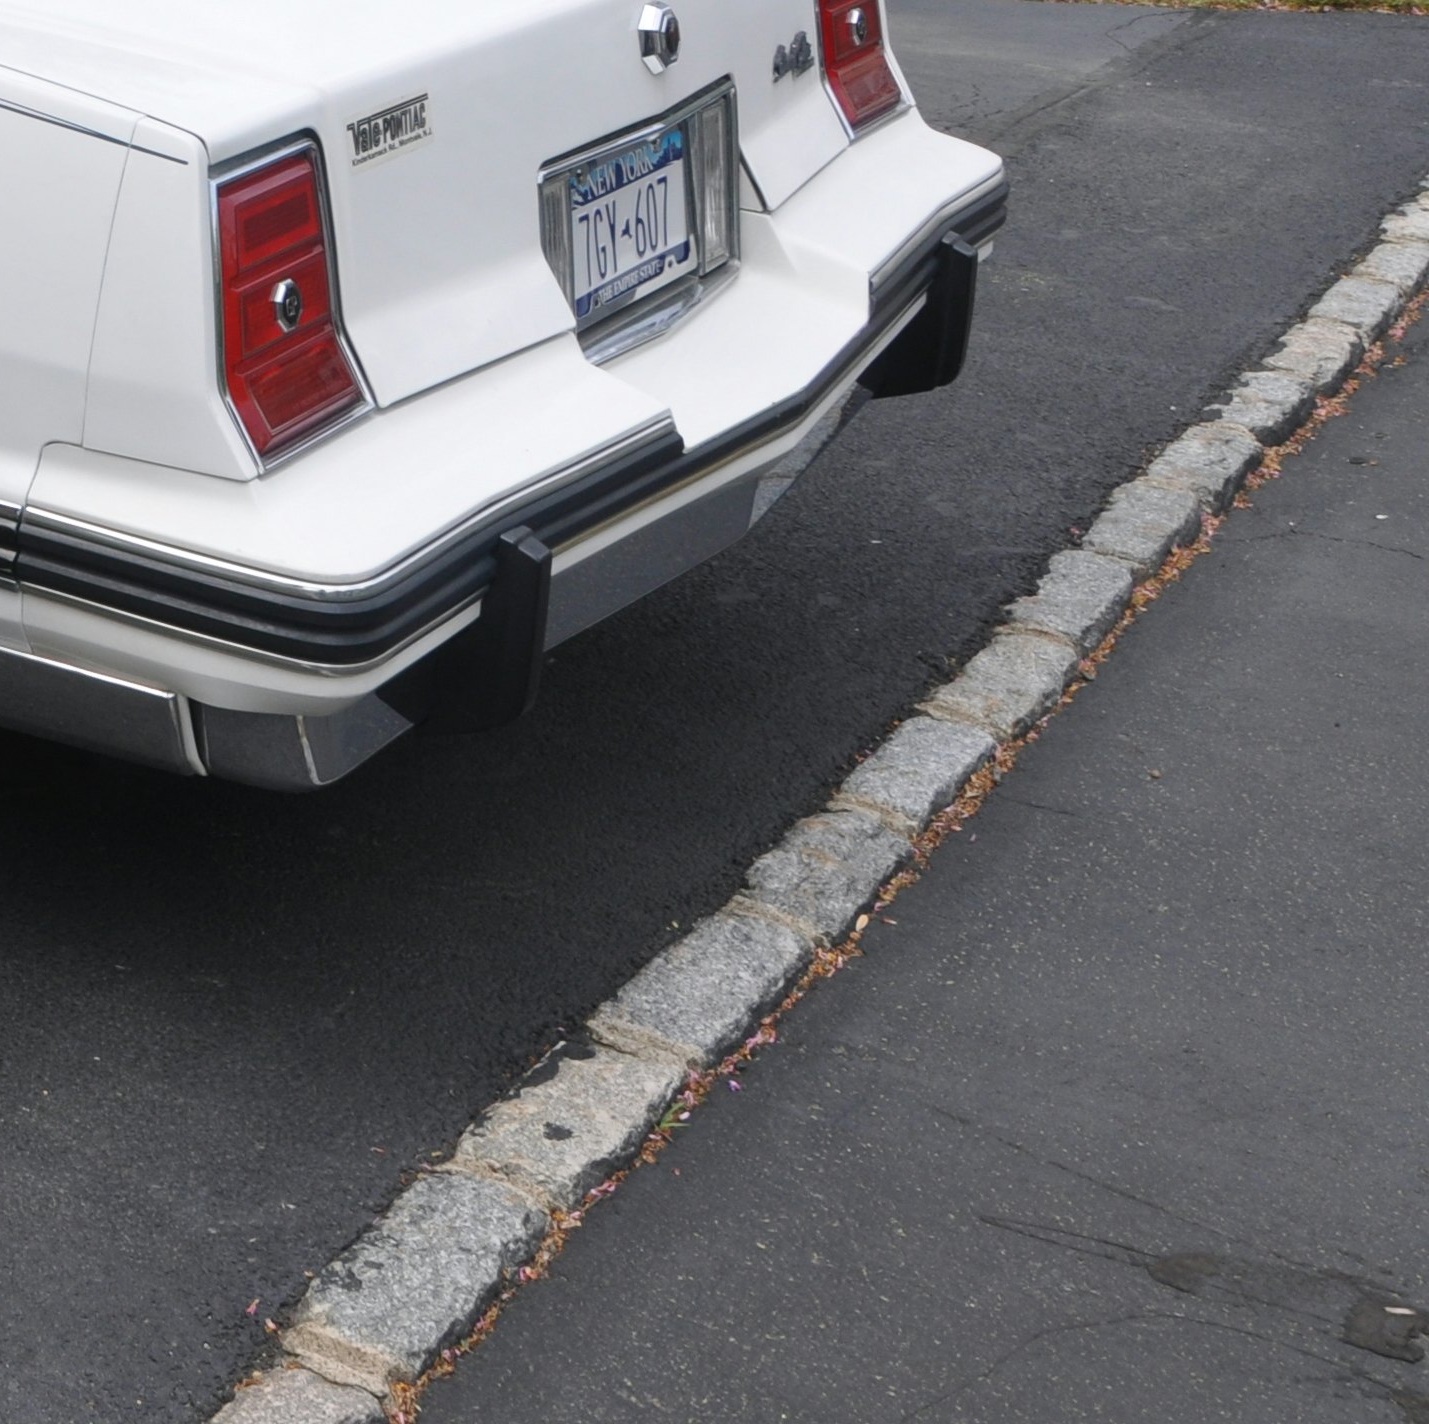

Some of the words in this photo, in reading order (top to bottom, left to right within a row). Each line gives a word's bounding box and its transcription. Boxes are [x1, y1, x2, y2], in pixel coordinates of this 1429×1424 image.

[383, 102, 426, 144] PONTIAC
[587, 160, 617, 200] NEW
[620, 146, 654, 184] YORK
[578, 200, 617, 287] 7GY
[635, 175, 668, 258] 607
